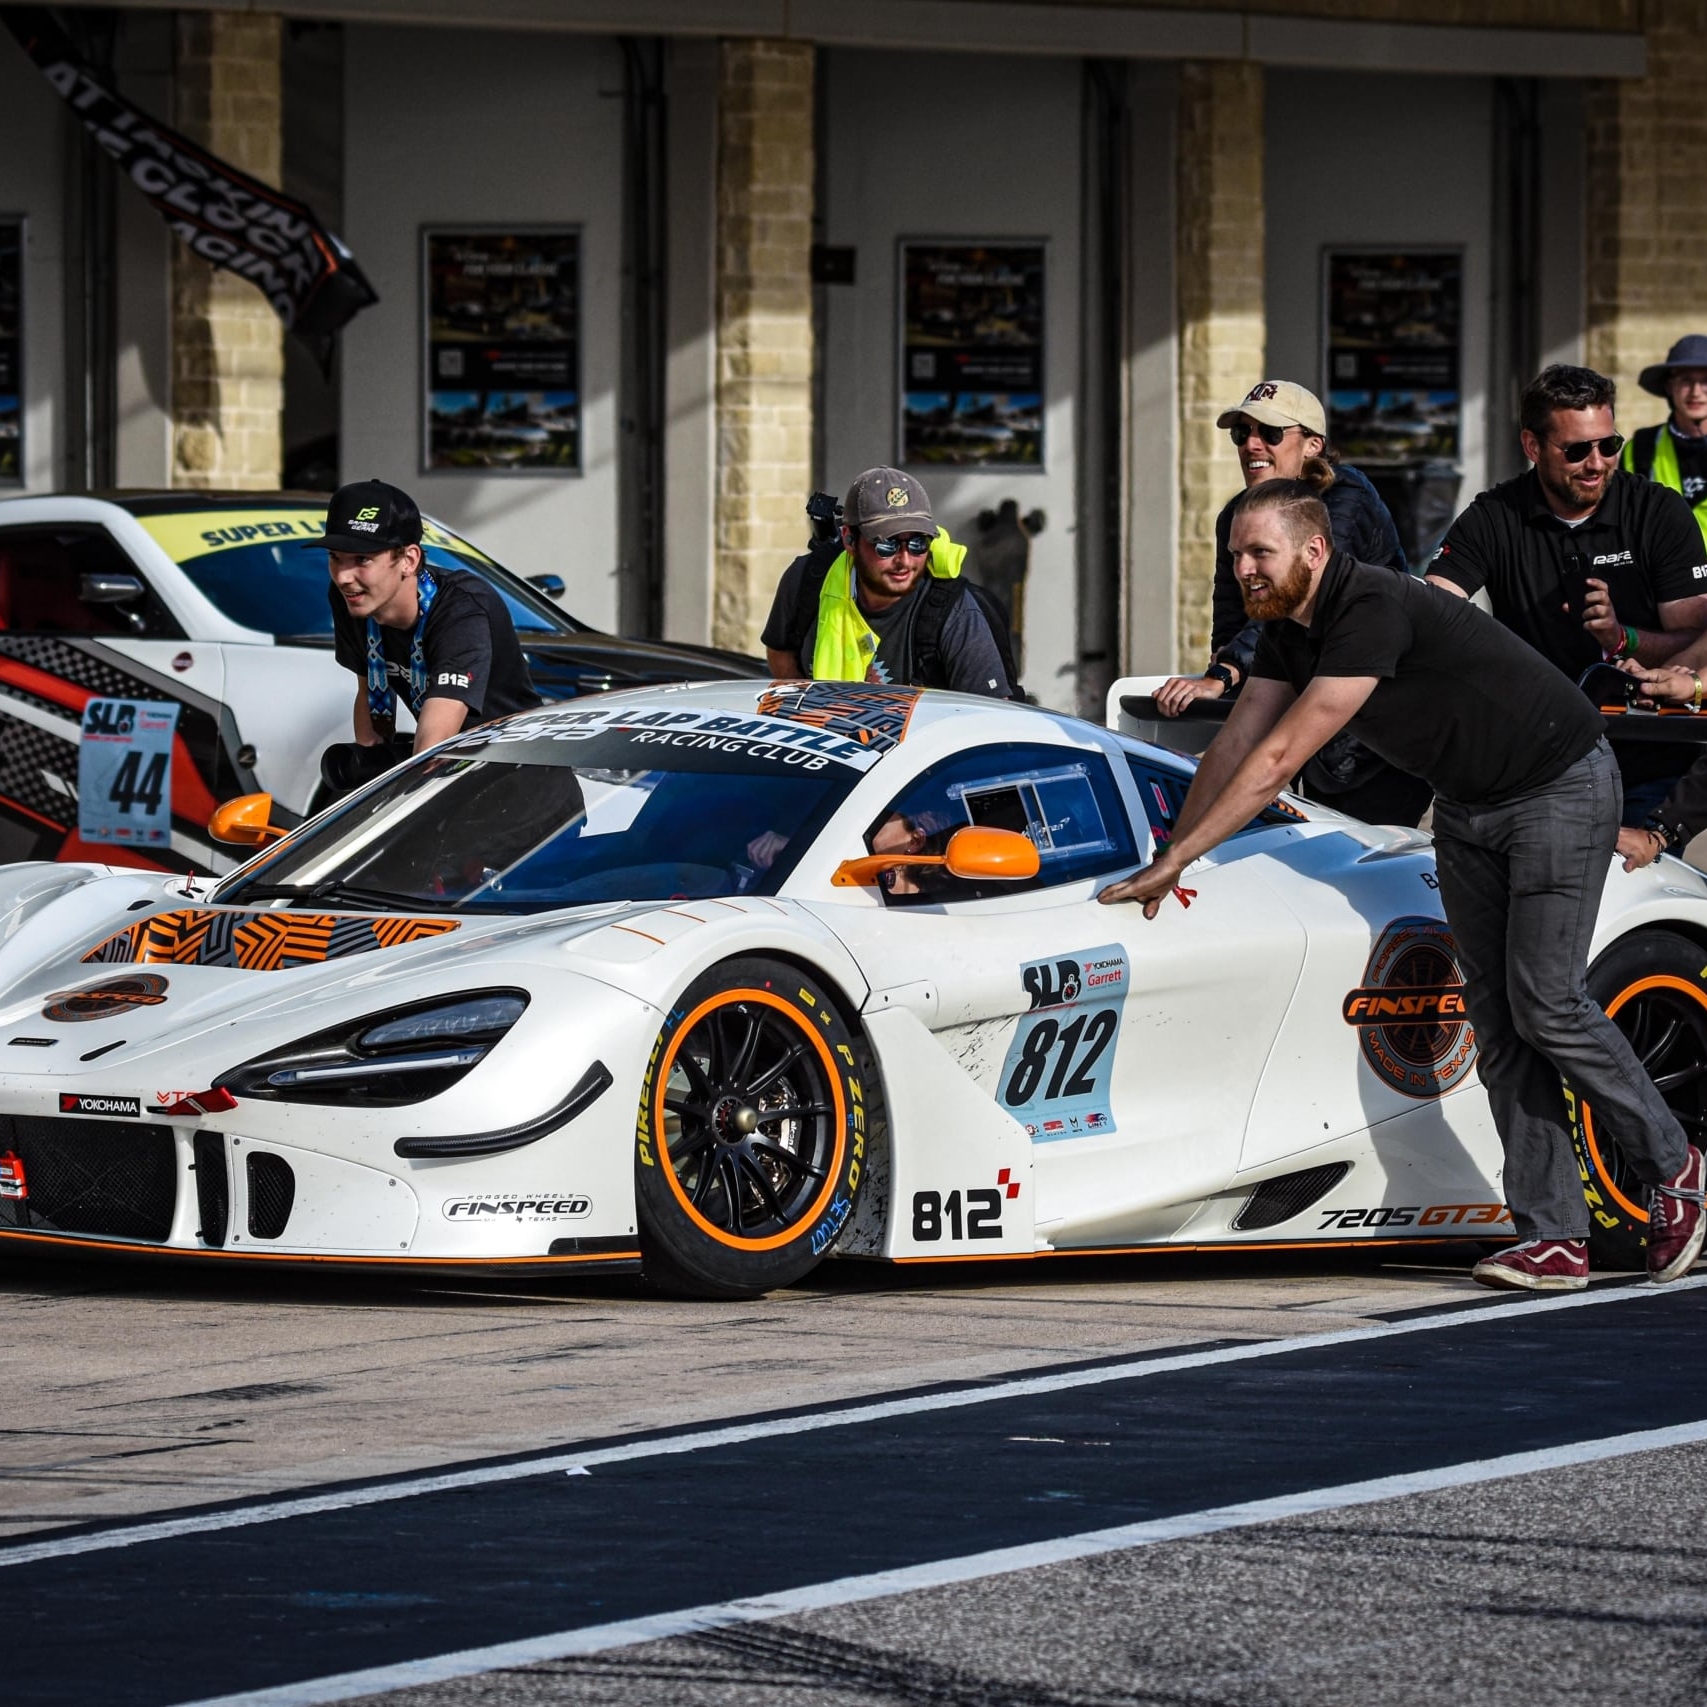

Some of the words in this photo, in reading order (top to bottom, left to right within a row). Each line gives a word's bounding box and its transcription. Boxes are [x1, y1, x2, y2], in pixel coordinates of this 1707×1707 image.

[201, 522, 295, 547] SUPER
[438, 672, 469, 689] 812
[84, 702, 136, 736] SLB
[603, 711, 702, 727] LAP
[694, 716, 872, 760] BATTLE
[630, 731, 744, 752] RACING
[747, 747, 830, 770] CLUB
[109, 751, 169, 815] 44
[1087, 970, 1122, 987] Garrett
[1092, 958, 1125, 971] YOKOHAMA
[1023, 959, 1082, 1010] SLB
[1004, 1008, 1119, 1107] 812
[1368, 1031, 1406, 1081] MADE
[1410, 1073, 1426, 1086] IN
[1430, 1029, 1475, 1084] TEXAS
[79, 1098, 138, 1113] YOKOHAMA
[638, 1032, 664, 1167] PIRELLI
[836, 1044, 855, 1066] P
[848, 1076, 866, 1193] ZERO
[449, 1200, 588, 1216] FINSPEED
[912, 1188, 1003, 1241] 812
[1317, 1207, 1421, 1230] 720S
